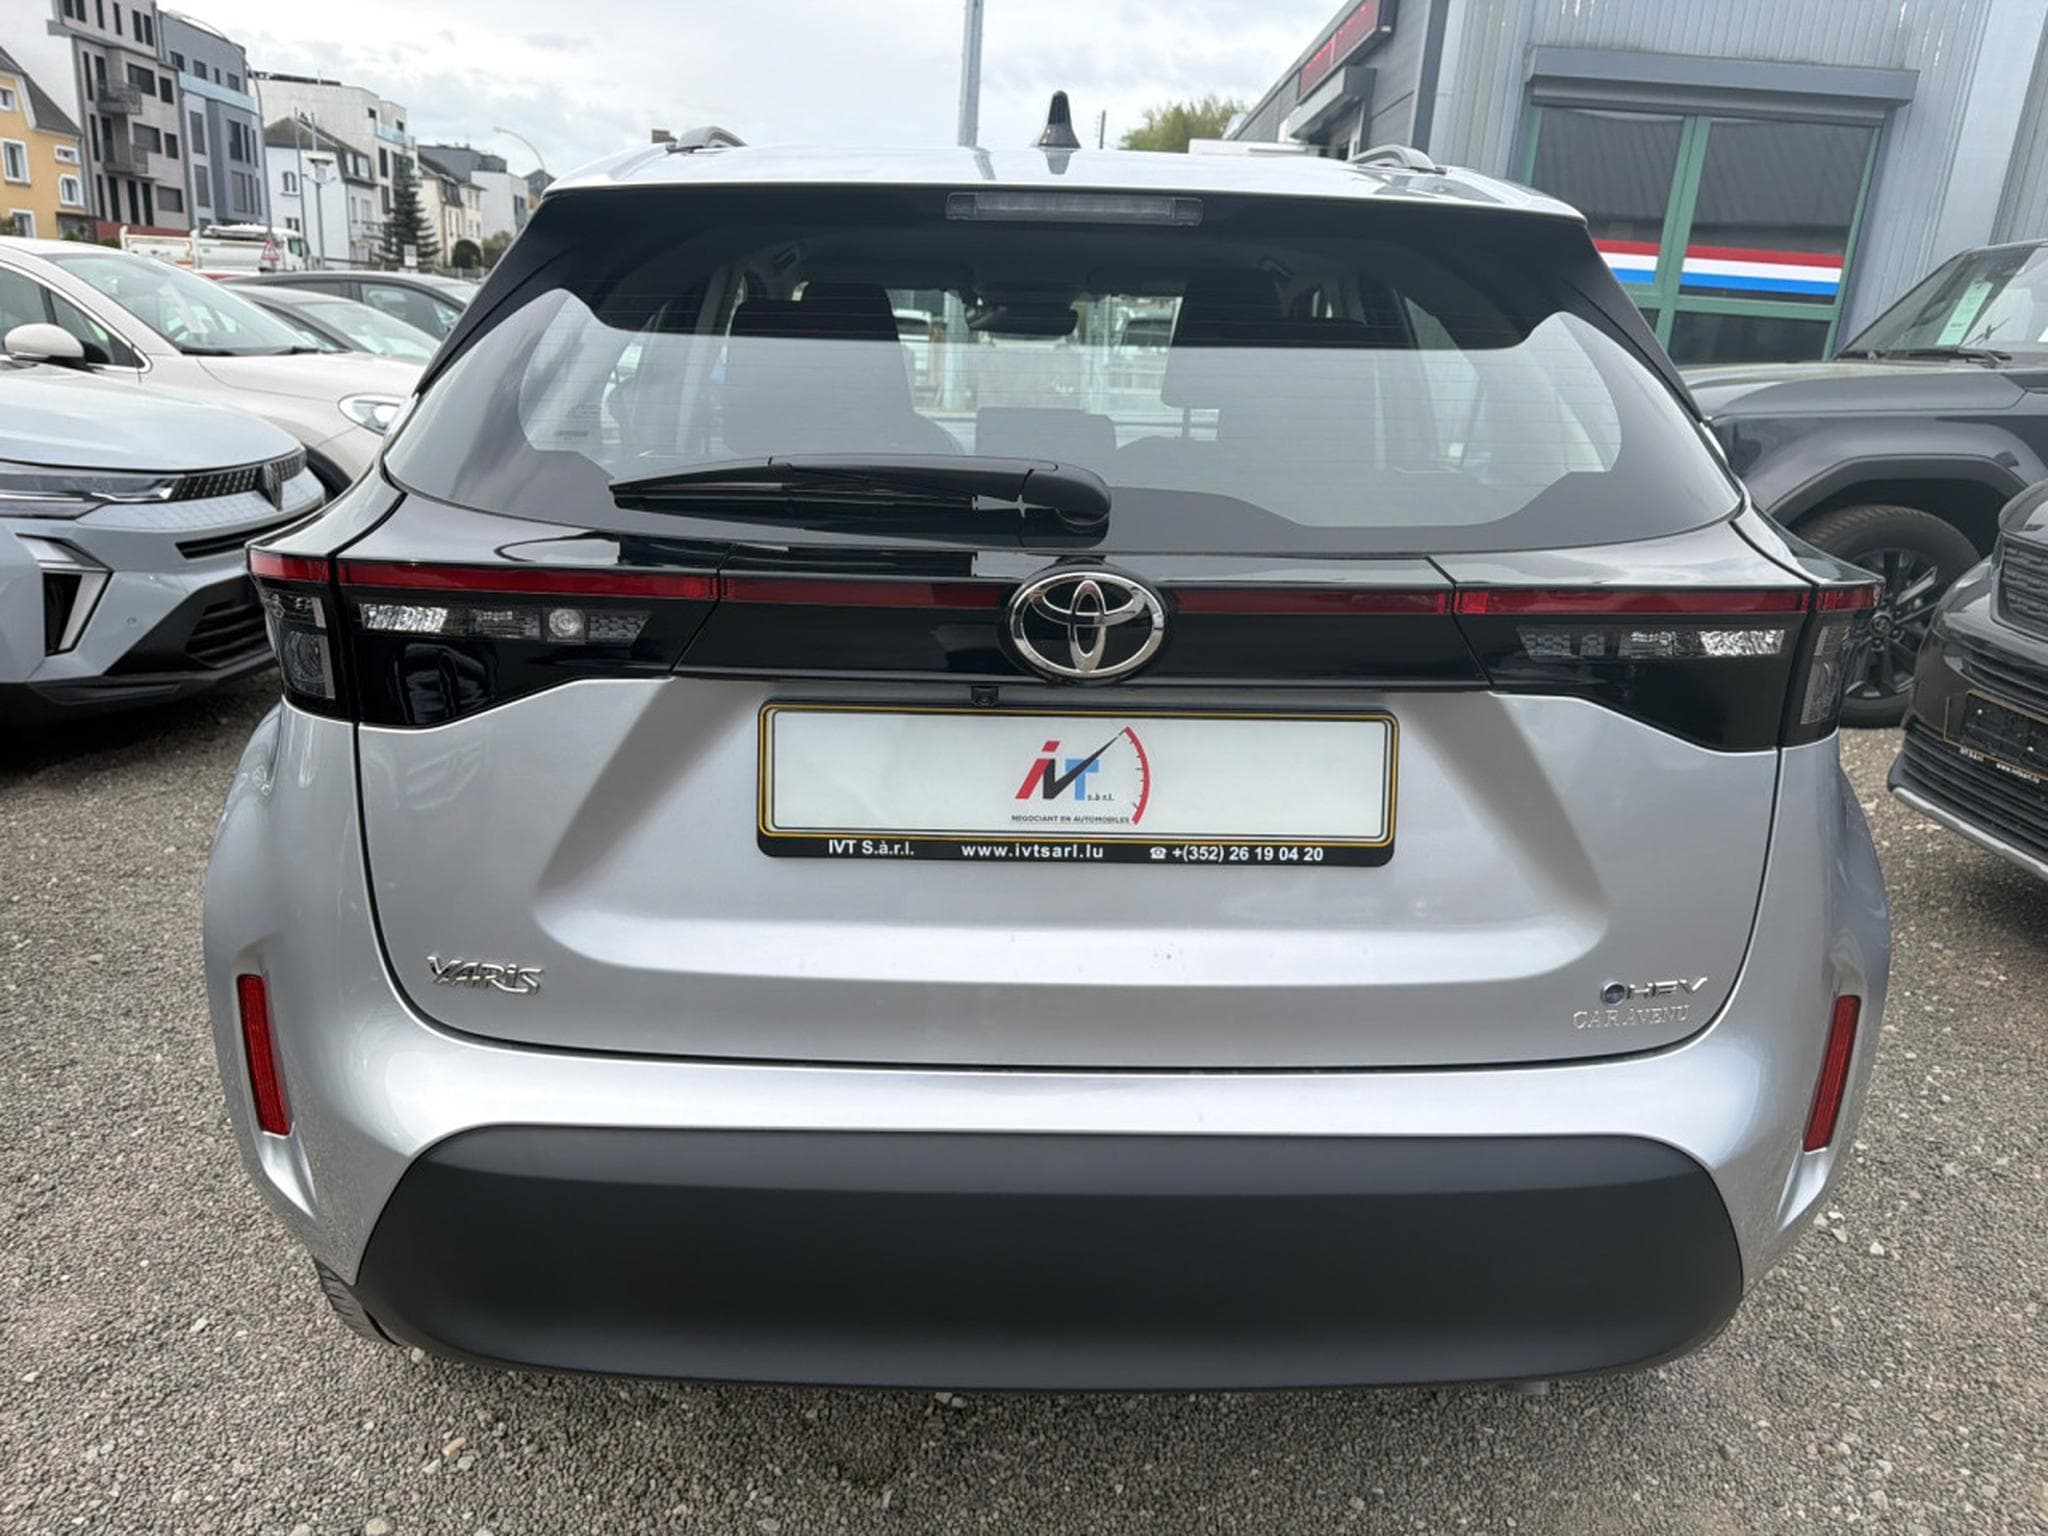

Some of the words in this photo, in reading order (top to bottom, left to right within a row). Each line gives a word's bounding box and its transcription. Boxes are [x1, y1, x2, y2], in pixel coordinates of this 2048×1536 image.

[1073, 816, 1130, 825] AUTOMOBILES
[828, 839, 856, 855] IVT
[861, 840, 914, 856] S.à.r.l.
[961, 843, 1104, 859] www.ivtsarl.lu
[1172, 845, 1225, 863] +(352)
[1229, 846, 1249, 861] 26
[1254, 846, 1274, 861] 19
[1278, 846, 1299, 861] 04
[1303, 846, 1324, 861] 20
[1626, 977, 1708, 1000] HEV
